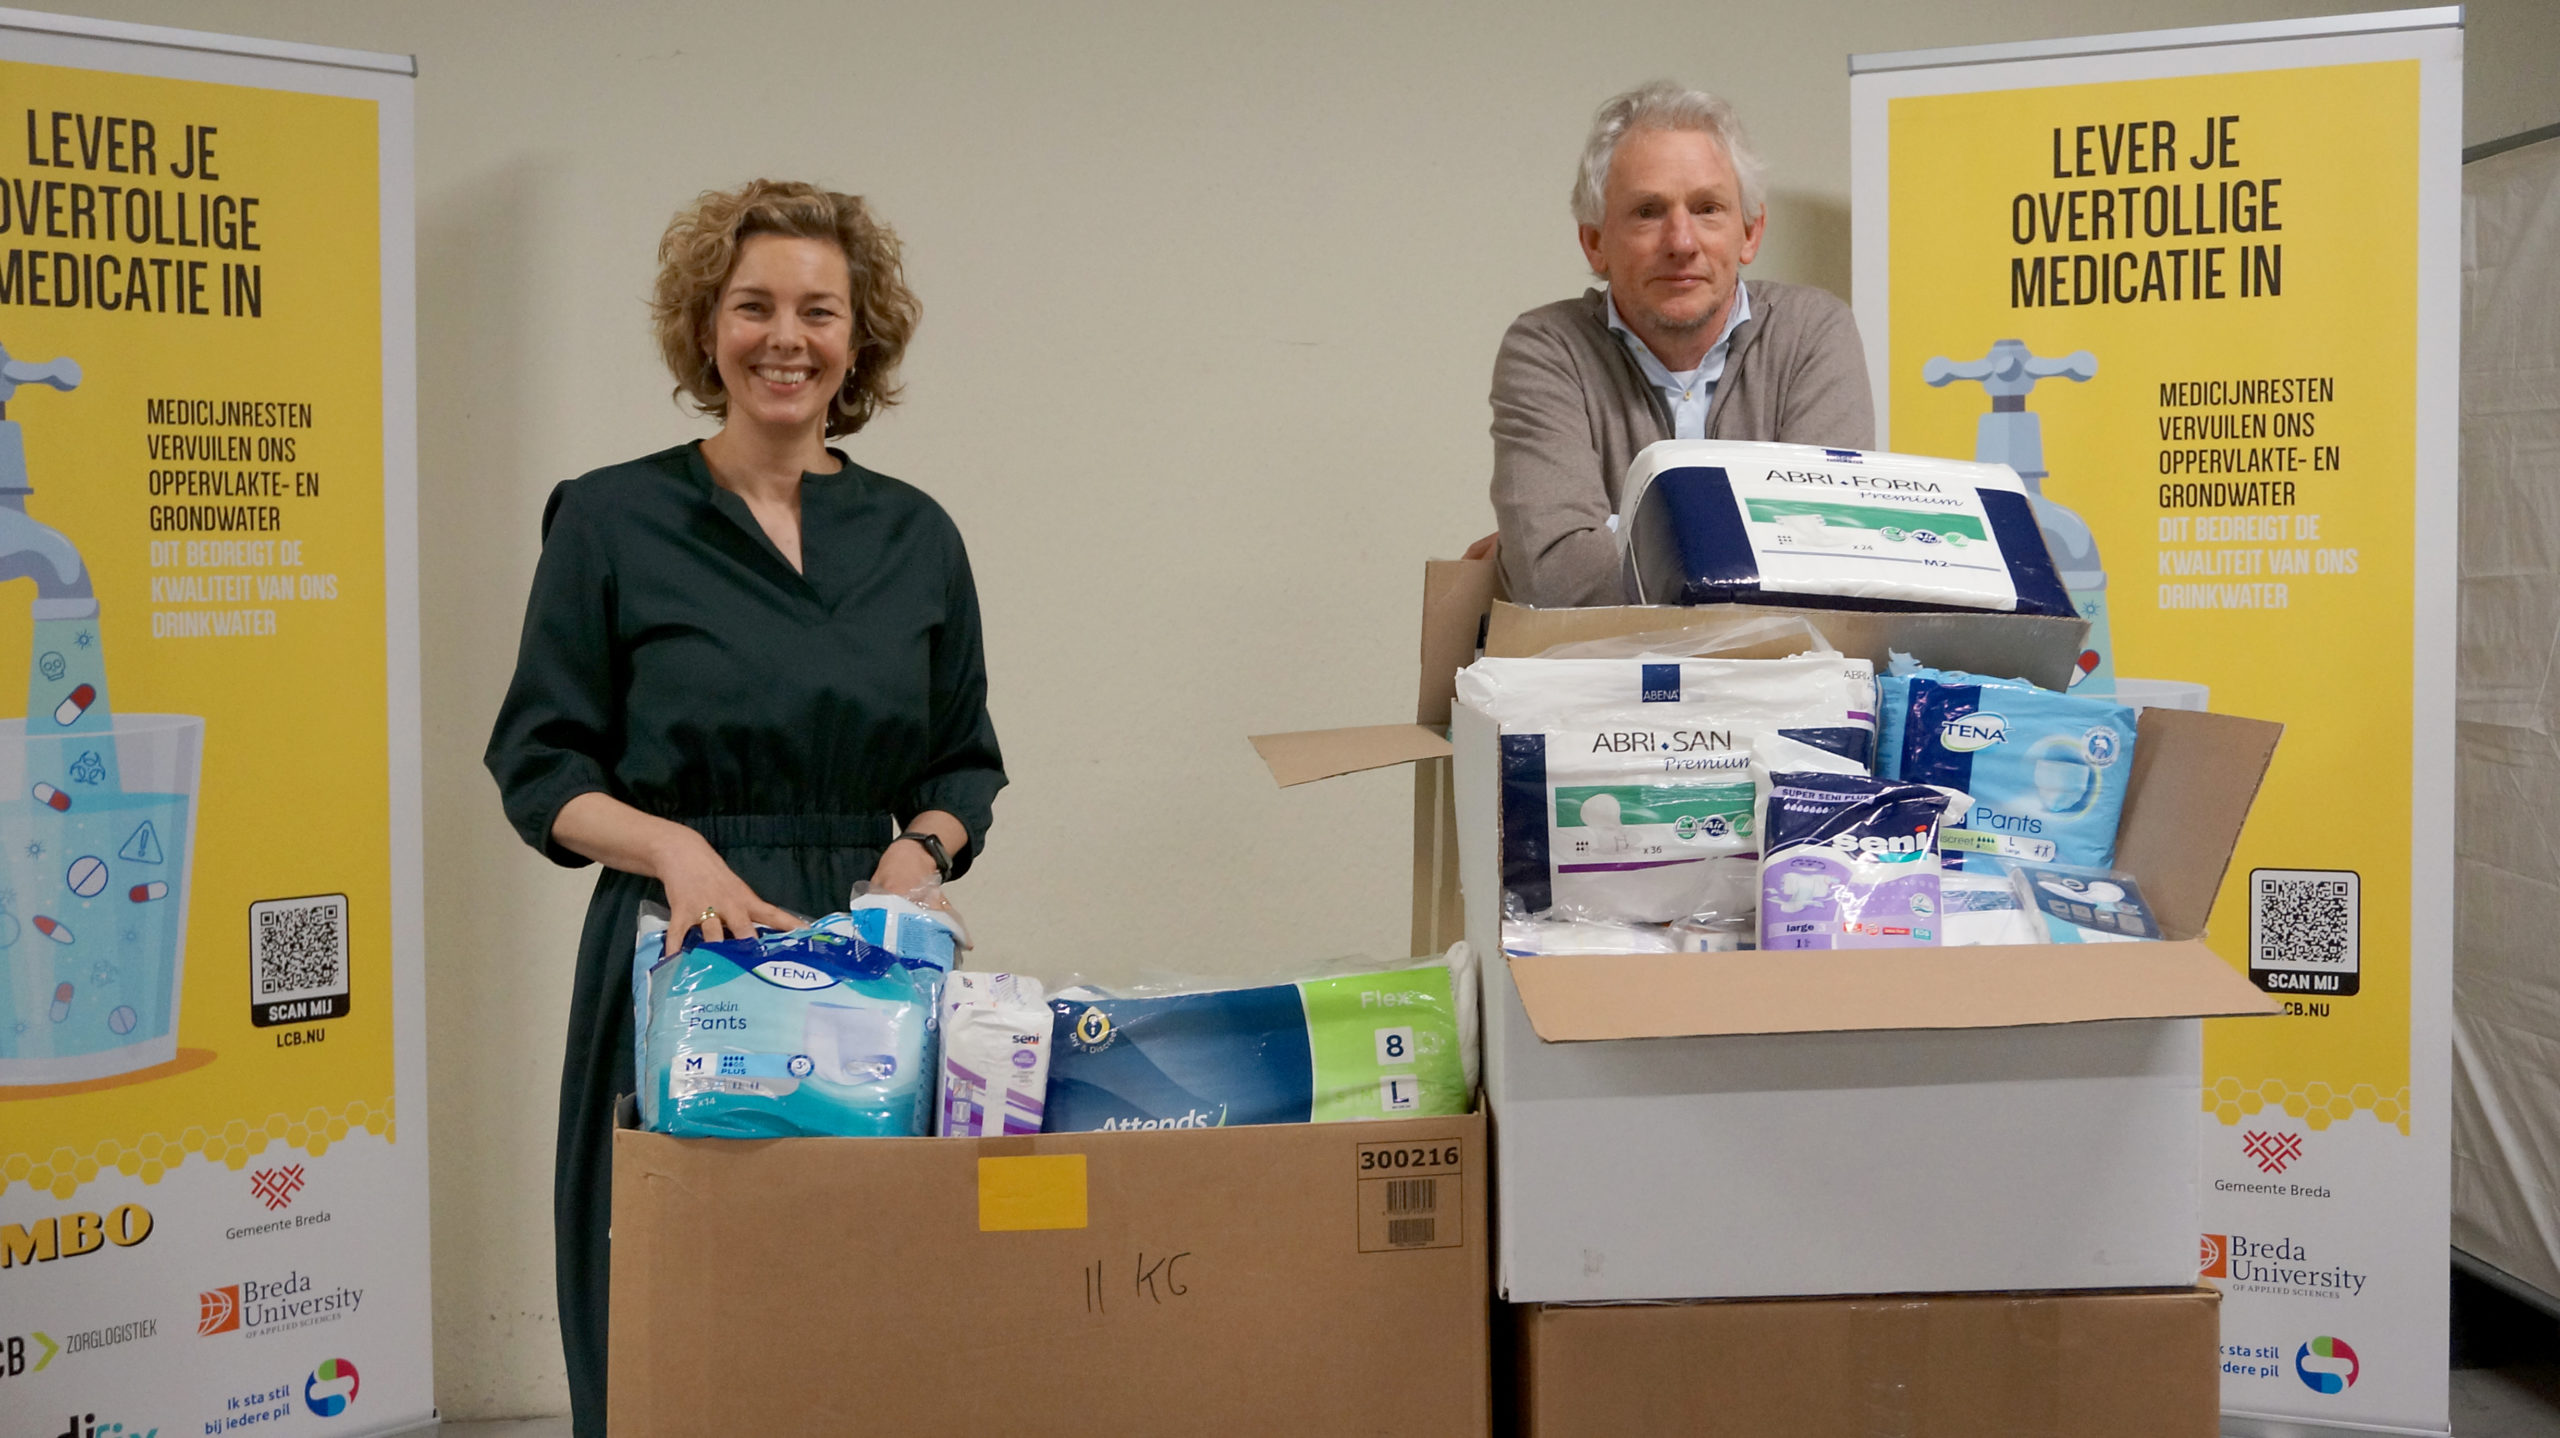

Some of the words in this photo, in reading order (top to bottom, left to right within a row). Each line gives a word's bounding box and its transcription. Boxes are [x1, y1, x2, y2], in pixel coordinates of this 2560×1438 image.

[27, 109, 156, 175] LEVER
[170, 124, 219, 181] JE
[2053, 120, 2175, 178] LEVER
[2190, 115, 2239, 170] JE
[2012, 178, 2282, 245] OVERTOLLIGE
[2011, 247, 2225, 308] MEDICATIE
[2241, 244, 2281, 298] IN
[223, 263, 262, 318] IN
[2160, 377, 2334, 407] MEDICIJNRESTEN
[147, 398, 312, 428] MEDICIJNRESTEN
[2159, 413, 2266, 441] VERVUILEN
[2273, 412, 2315, 438] ONS
[147, 434, 251, 461] VERVUILEN
[258, 437, 296, 462] ONS
[2159, 446, 2307, 475] OPPERVLAKTE-
[2314, 446, 2340, 471] EN
[149, 469, 290, 497] OPPERVLAKTE-
[296, 472, 319, 497] EN
[1766, 470, 1833, 486] ABRI
[1852, 476, 1941, 493] FORM
[2159, 481, 2295, 508] GRONDWATER
[1860, 489, 1964, 507] Premium
[150, 506, 280, 531] GRONDWATER
[2159, 516, 2190, 542] DIT
[2195, 515, 2289, 541] BEDREIGT
[2294, 514, 2320, 540] DE
[151, 540, 180, 567] DIT
[187, 540, 275, 567] BEDREIGT
[281, 540, 303, 566] DE
[1924, 559, 1949, 568] M2
[2159, 549, 2263, 576] KWALITEIT
[2268, 549, 2309, 575] VAN
[2315, 547, 2359, 574] ONS
[151, 574, 253, 603] KWALITEIT
[257, 574, 294, 601] VAN
[300, 573, 338, 600] ONS
[2158, 582, 2288, 610] DRINKWATER
[152, 609, 276, 638] DRINKWATER
[1643, 690, 1678, 700] ABENA
[1592, 732, 1655, 752] ABRI
[1673, 731, 1731, 751] SAN
[1942, 722, 2007, 743] TENA
[1782, 788, 1816, 799] SUPER
[1818, 793, 1842, 801] SENI
[1703, 820, 1724, 829] Air
[1976, 807, 2042, 833] Pants
[1651, 846, 1662, 854] 36
[1832, 824, 1928, 852] seni
[1940, 834, 1974, 845] iscreet
[2009, 837, 2015, 846] L
[1786, 923, 1814, 933] large
[769, 966, 818, 982] TENA
[2268, 973, 2310, 990] SCAN
[2314, 975, 2339, 991] MIJ
[269, 1002, 307, 1022] SCAN
[310, 999, 333, 1016] MIJ
[1361, 990, 1410, 1008] Flex
[2284, 1002, 2330, 1017] CB.NU
[690, 1016, 747, 1030] Pants
[276, 1028, 325, 1048] LCB.NU
[1012, 1033, 1040, 1044] seni
[1386, 1034, 1404, 1057] 8
[685, 1057, 702, 1071] M
[1391, 1081, 1410, 1104] L
[1360, 1146, 1459, 1171] 300216
[2214, 1179, 2286, 1195] Gemeente
[2290, 1184, 2331, 1199] Breda
[225, 1218, 292, 1240] Gemeente
[295, 1210, 331, 1228] Breda
[2231, 1235, 2307, 1261] Breda
[243, 1271, 311, 1303] Breda
[1136, 1252, 1192, 1305] KG
[2232, 1259, 2368, 1296] University
[2233, 1283, 2245, 1291] OF
[2247, 1285, 2290, 1295] APPLIED
[2292, 1288, 2340, 1299] SCIENCES
[244, 1286, 364, 1327] University
[66, 1319, 158, 1354] ZORGLOGISTIEK
[246, 1331, 257, 1339] OF
[260, 1322, 298, 1336] APPLIED
[300, 1313, 342, 1327] SCIENCES
[2229, 1345, 2251, 1357] sta
[2255, 1346, 2279, 1359] stil
[2261, 1364, 2279, 1379] pil
[227, 1398, 240, 1411] Ik
[244, 1390, 265, 1406] sta
[269, 1384, 290, 1401] stil
[205, 1419, 222, 1435] bij
[226, 1412, 269, 1430] iedere
[273, 1403, 290, 1422] pil
